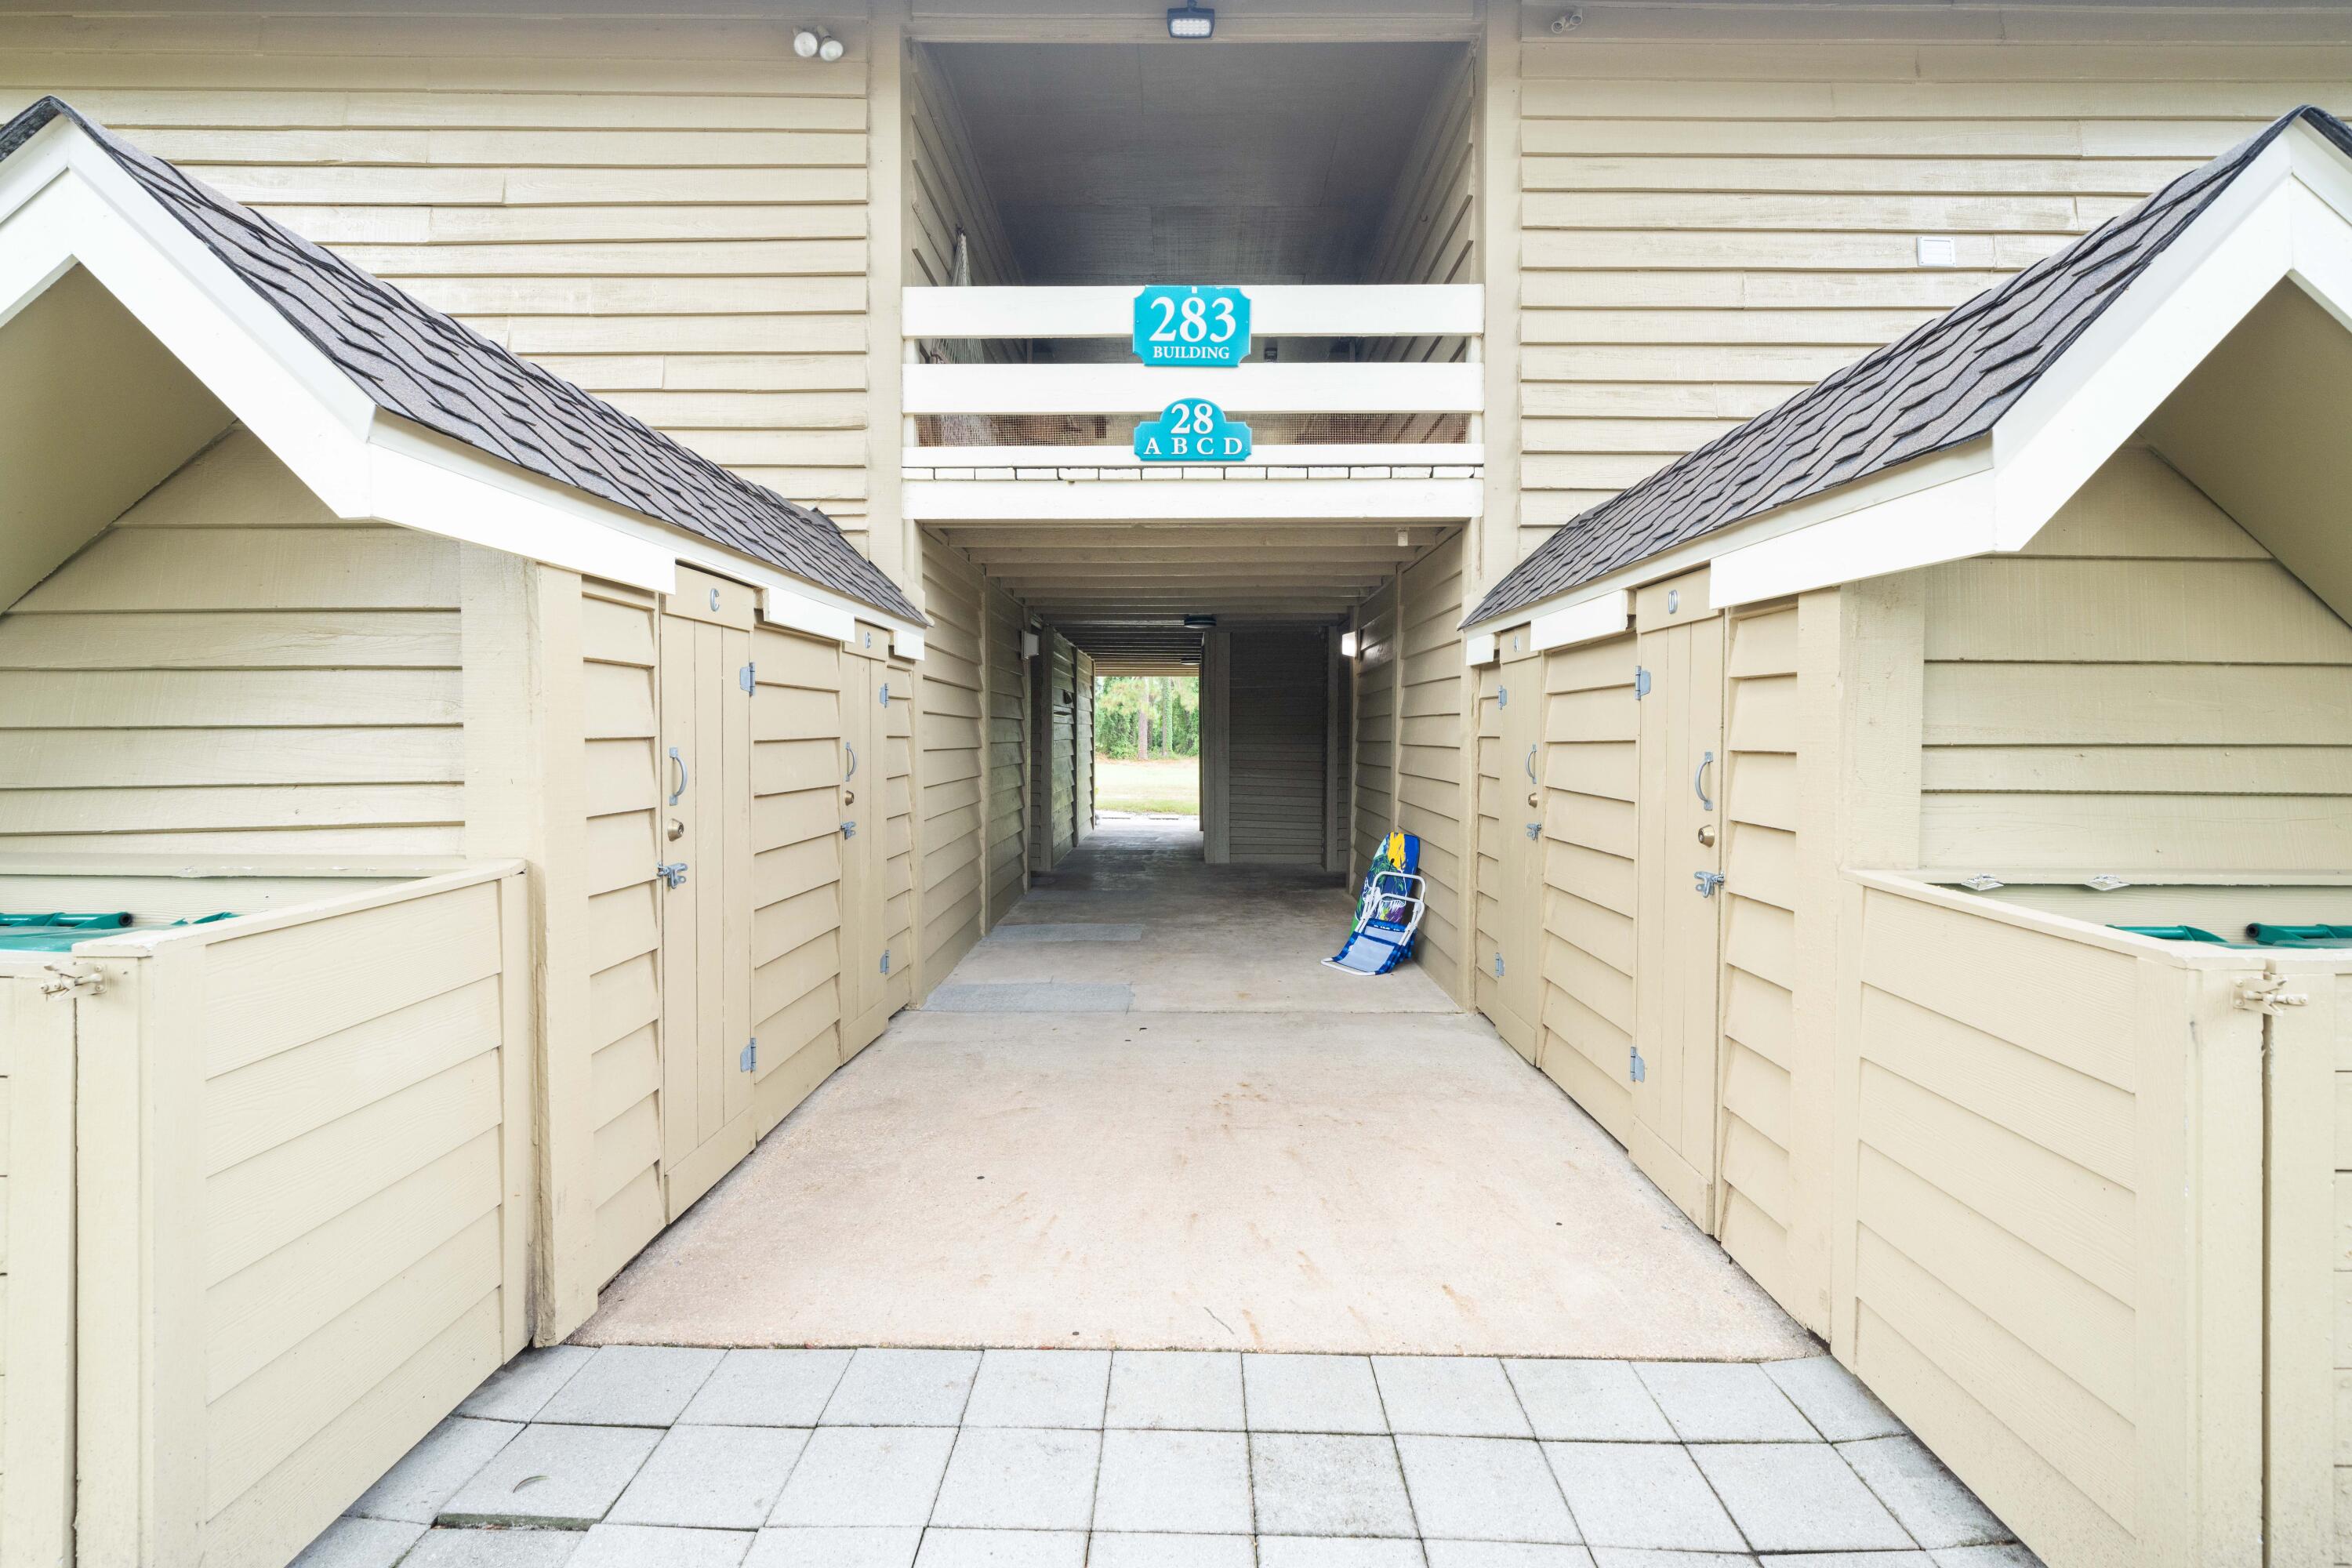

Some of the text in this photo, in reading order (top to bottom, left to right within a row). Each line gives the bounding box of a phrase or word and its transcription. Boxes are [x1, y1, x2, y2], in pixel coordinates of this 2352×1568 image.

[1149, 296, 1236, 343] 283
[1153, 346, 1230, 359] BUILDING
[1171, 403, 1214, 434] 28
[1143, 437, 1243, 455] A B C D
[710, 588, 720, 612] C
[865, 631, 872, 649] B
